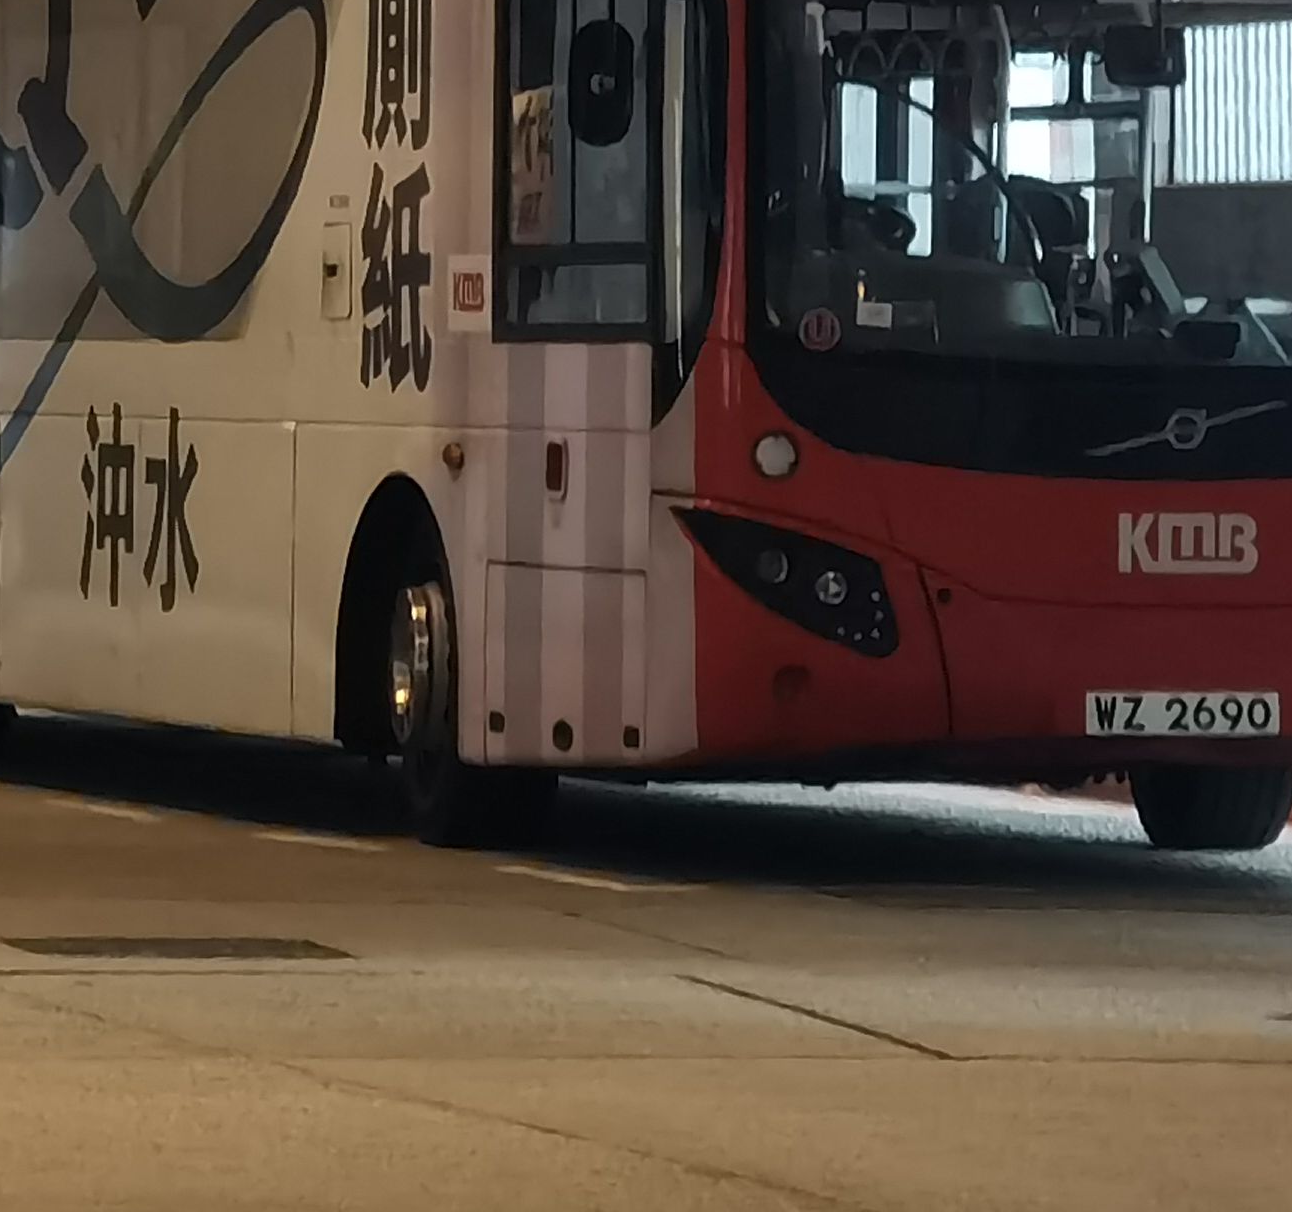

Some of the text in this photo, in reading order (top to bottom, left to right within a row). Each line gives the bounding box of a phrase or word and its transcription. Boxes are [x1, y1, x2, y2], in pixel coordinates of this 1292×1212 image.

[79, 401, 200, 613] 沖水
[1117, 512, 1259, 574] KMB
[1094, 695, 1273, 732] WZ 2690
